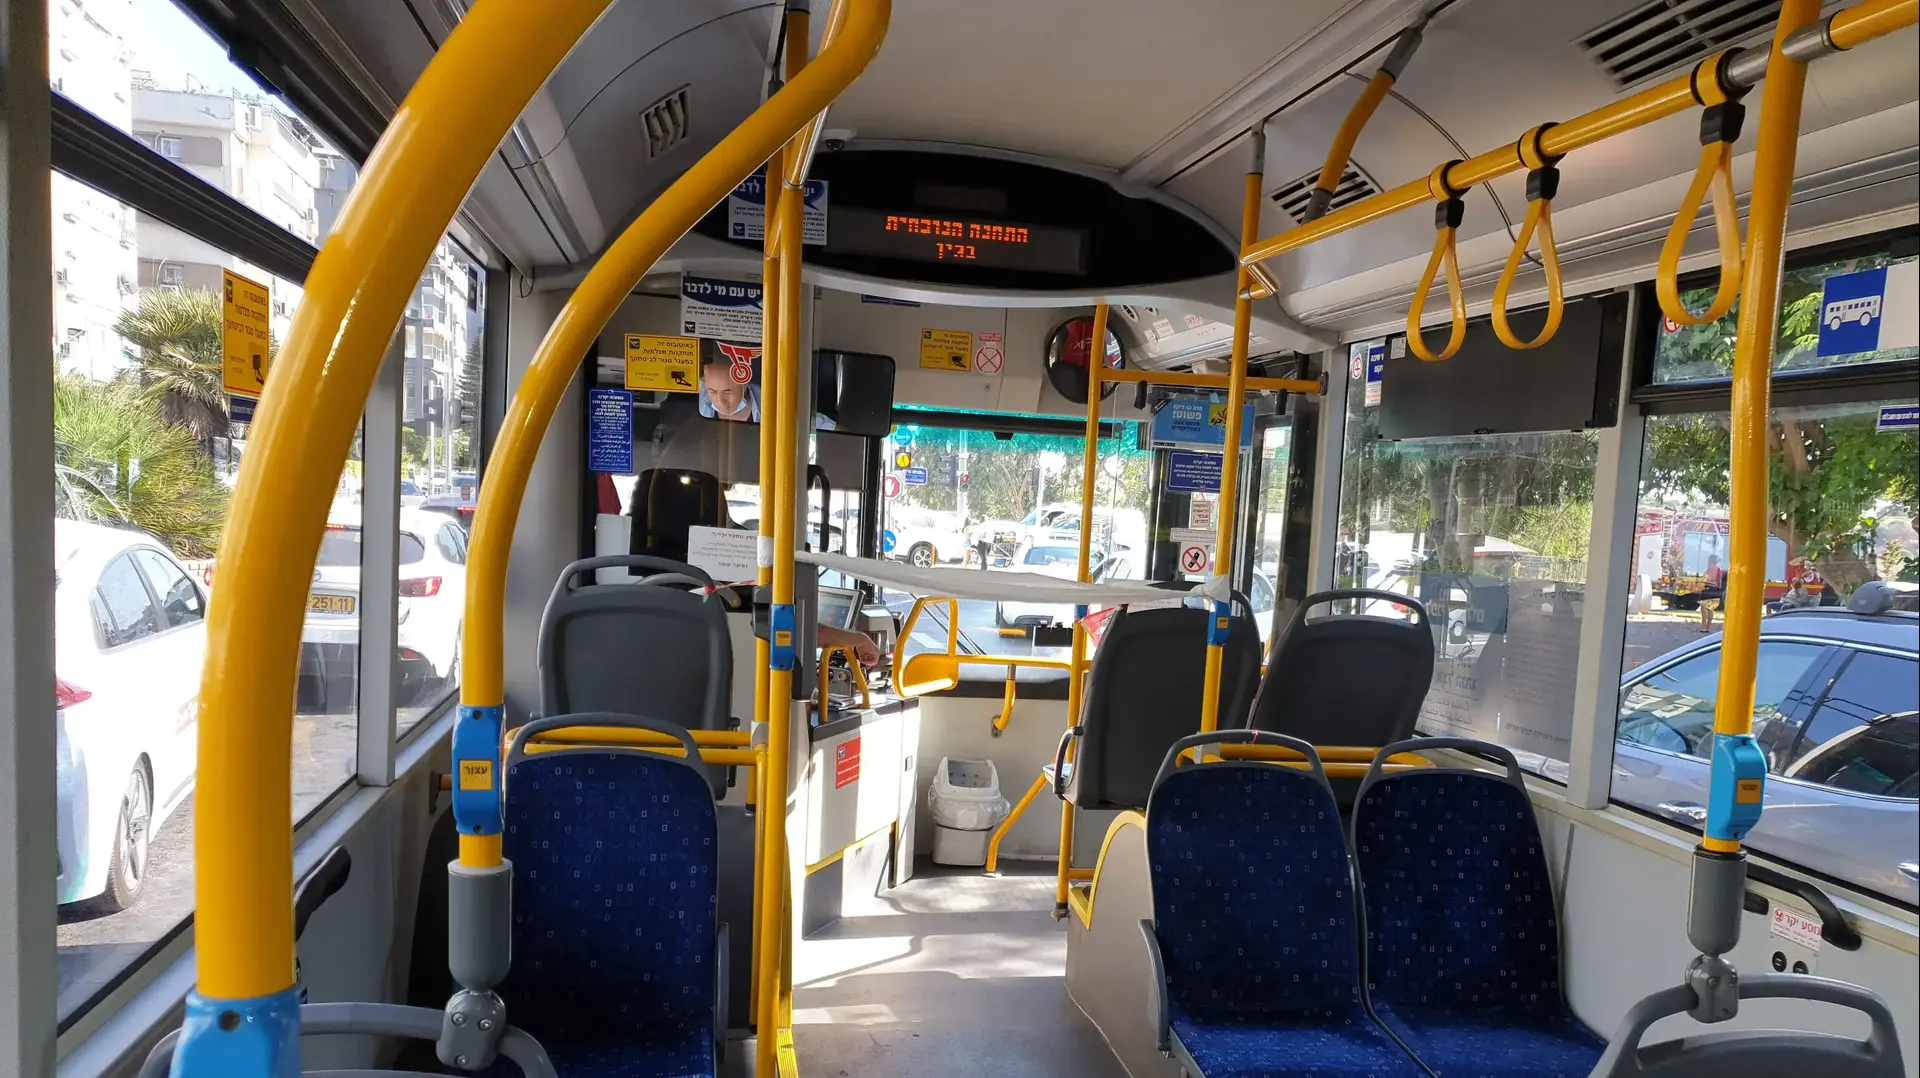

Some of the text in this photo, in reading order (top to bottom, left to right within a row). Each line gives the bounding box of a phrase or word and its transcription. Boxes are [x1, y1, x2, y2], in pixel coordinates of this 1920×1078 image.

[885, 215, 1028, 243] התחנה הנוכחית
[936, 243, 976, 259] בגין
[684, 282, 760, 298] יש עם מי לדבר
[463, 766, 488, 775] עצור
[1785, 914, 1799, 928] יקר
